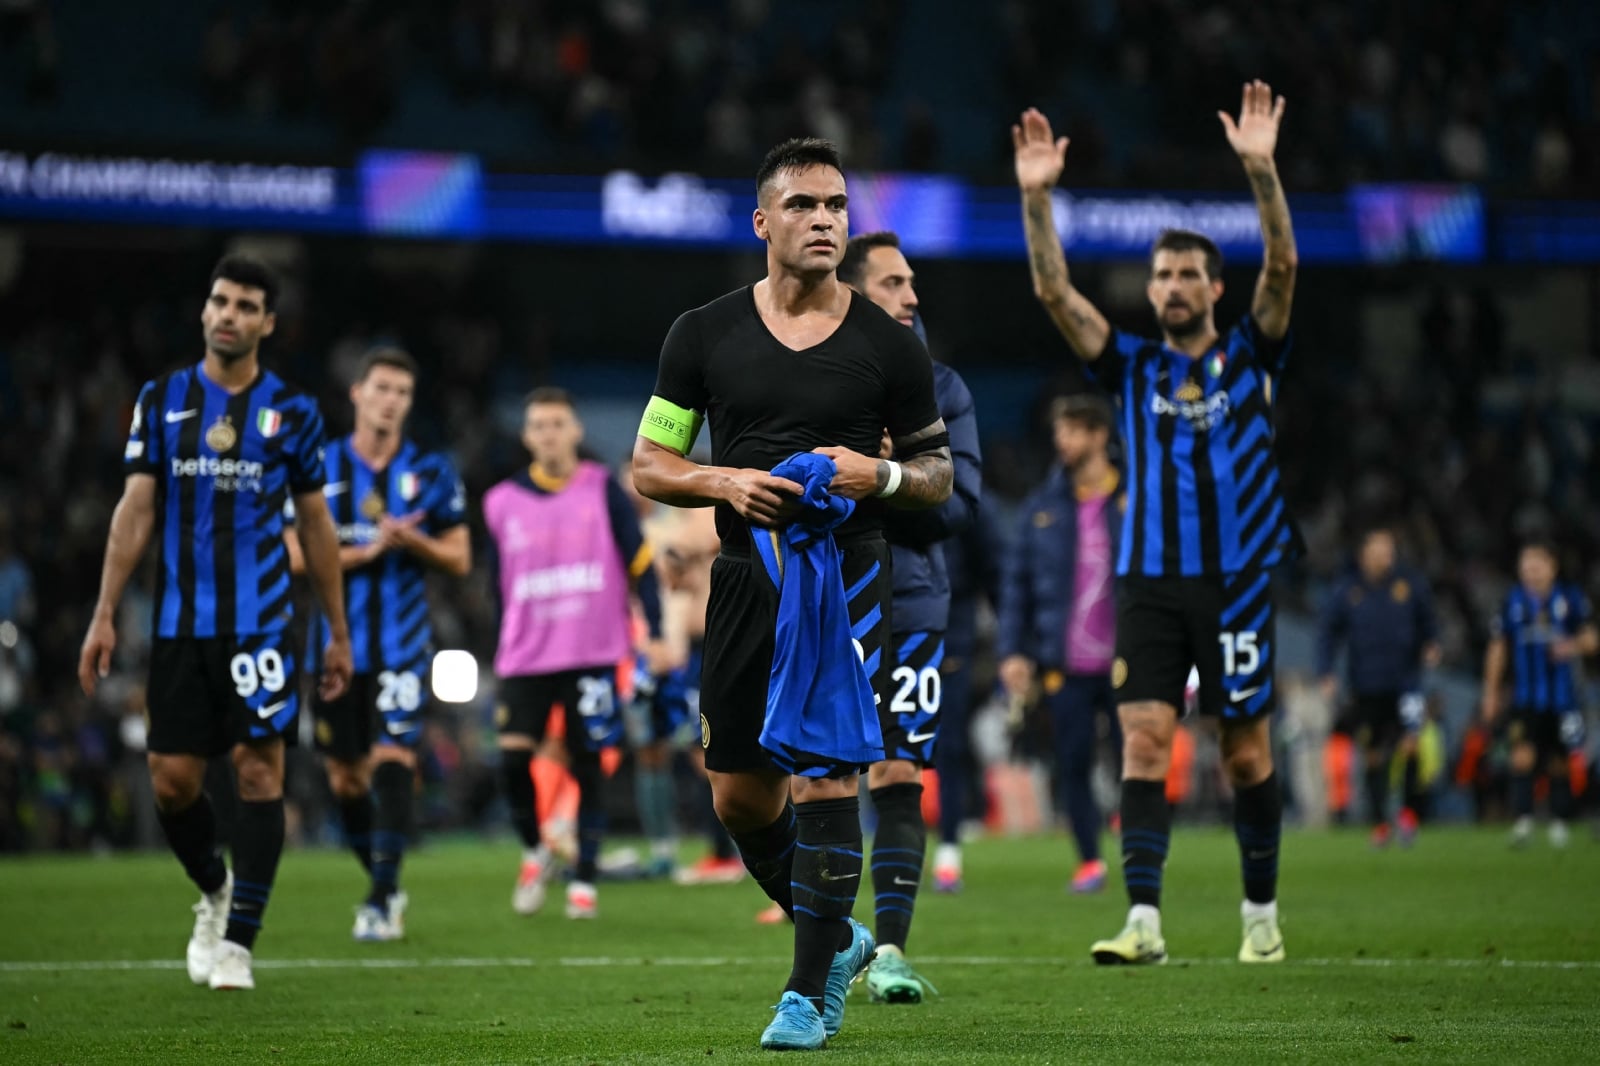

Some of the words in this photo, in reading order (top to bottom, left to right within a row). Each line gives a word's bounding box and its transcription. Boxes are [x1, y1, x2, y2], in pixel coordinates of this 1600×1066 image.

[602, 170, 731, 238] FedEx
[171, 455, 263, 478] betsson
[230, 648, 285, 697] 99
[1219, 631, 1260, 676] 15
[376, 670, 420, 711] 28
[890, 666, 941, 714] 20
